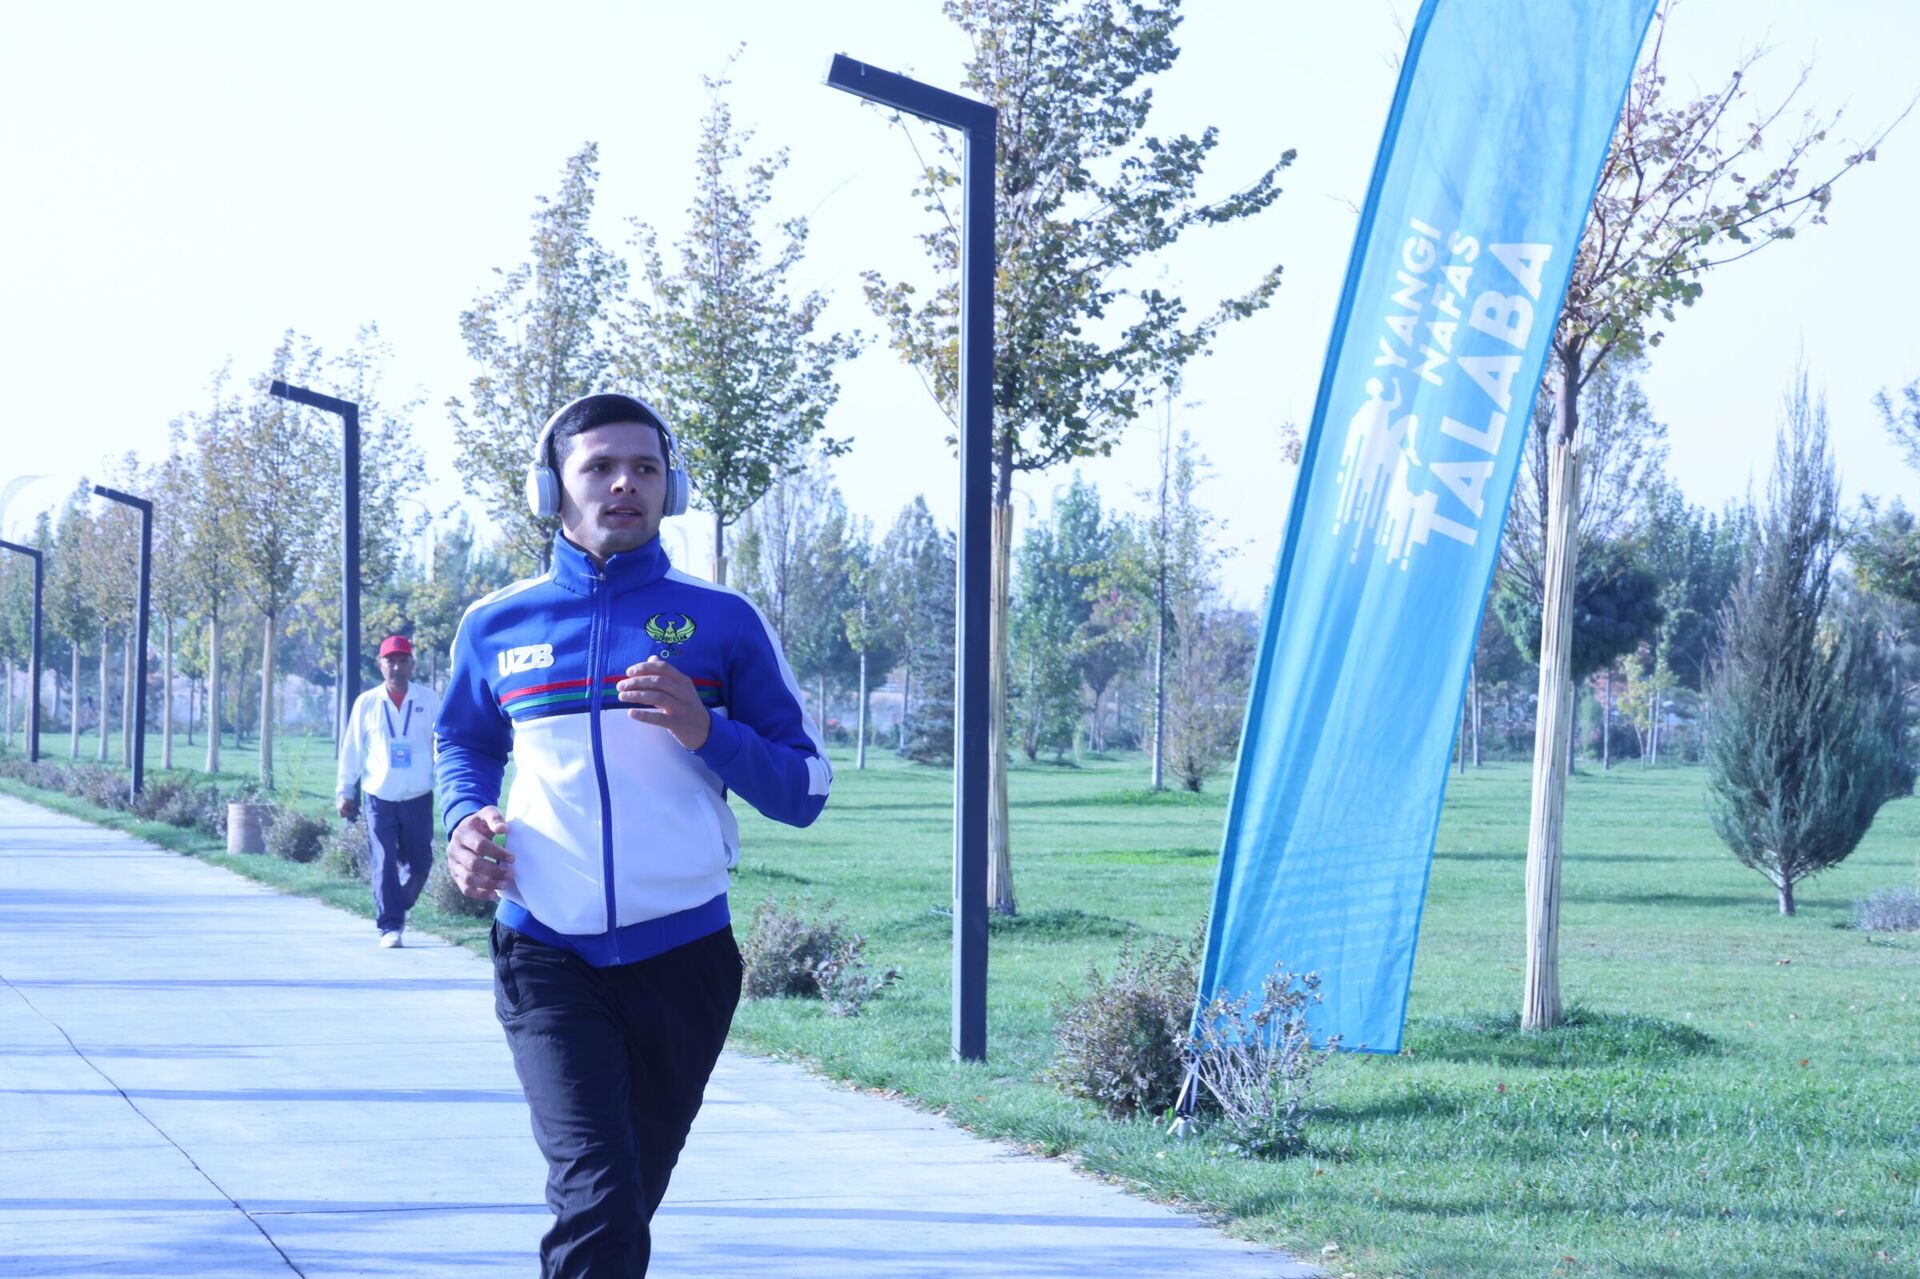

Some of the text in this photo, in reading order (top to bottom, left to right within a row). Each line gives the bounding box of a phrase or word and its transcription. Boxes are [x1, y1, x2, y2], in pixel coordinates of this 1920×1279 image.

[1374, 218, 1441, 368] YANGI
[1413, 231, 1480, 386] NAFAS
[1412, 243, 1552, 546] TALABA
[498, 643, 554, 676] UZB
